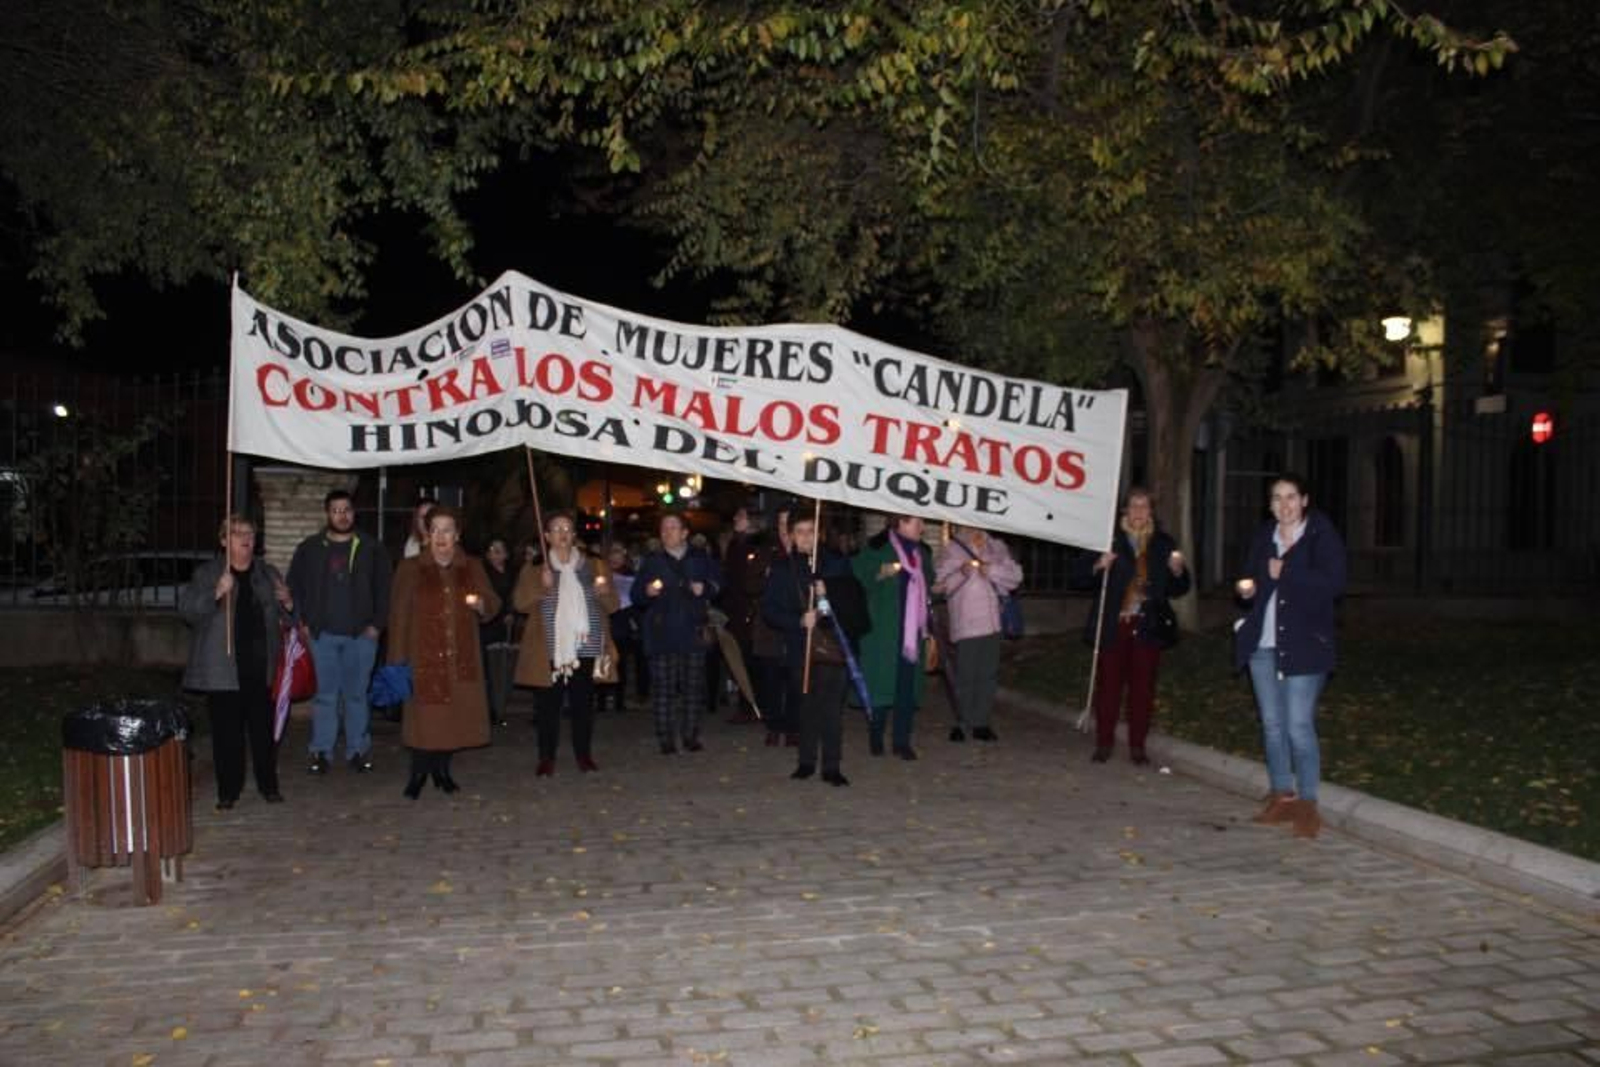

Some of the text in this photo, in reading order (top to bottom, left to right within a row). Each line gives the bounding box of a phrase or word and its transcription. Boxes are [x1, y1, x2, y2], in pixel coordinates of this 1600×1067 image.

[248, 285, 1094, 432] ASOCIACION DE MUJERES "CANDELA"
[256, 346, 1087, 490] CONTRA LOS MALOS TRATOS
[348, 399, 1013, 516] HINOJOSA DEL DUQUE
